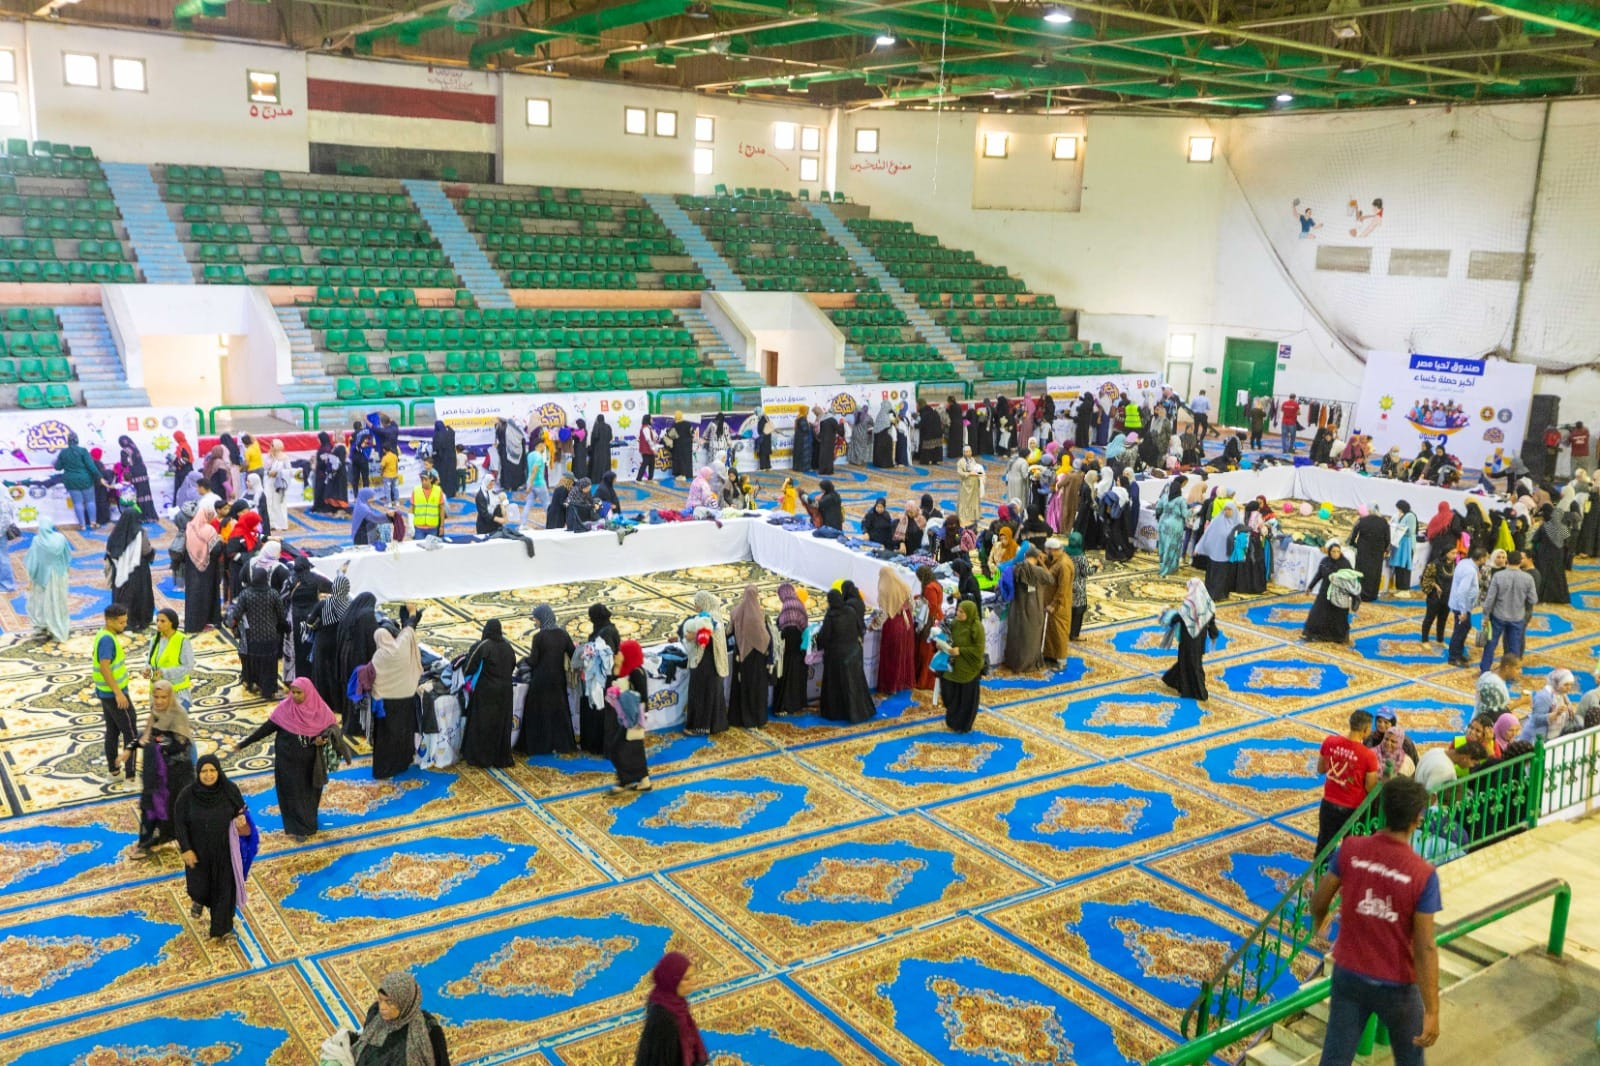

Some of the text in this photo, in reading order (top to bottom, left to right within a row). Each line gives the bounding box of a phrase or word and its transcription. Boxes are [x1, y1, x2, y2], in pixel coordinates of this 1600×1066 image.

[250, 104, 293, 119] مدرج ٥
[744, 144, 765, 158] مدرج
[888, 160, 911, 175] ممنوع
[1416, 360, 1480, 373] صندوق تحيا مصر
[1414, 374, 1475, 388] أكبر حملة كساء
[28, 434, 69, 451] لفرحة
